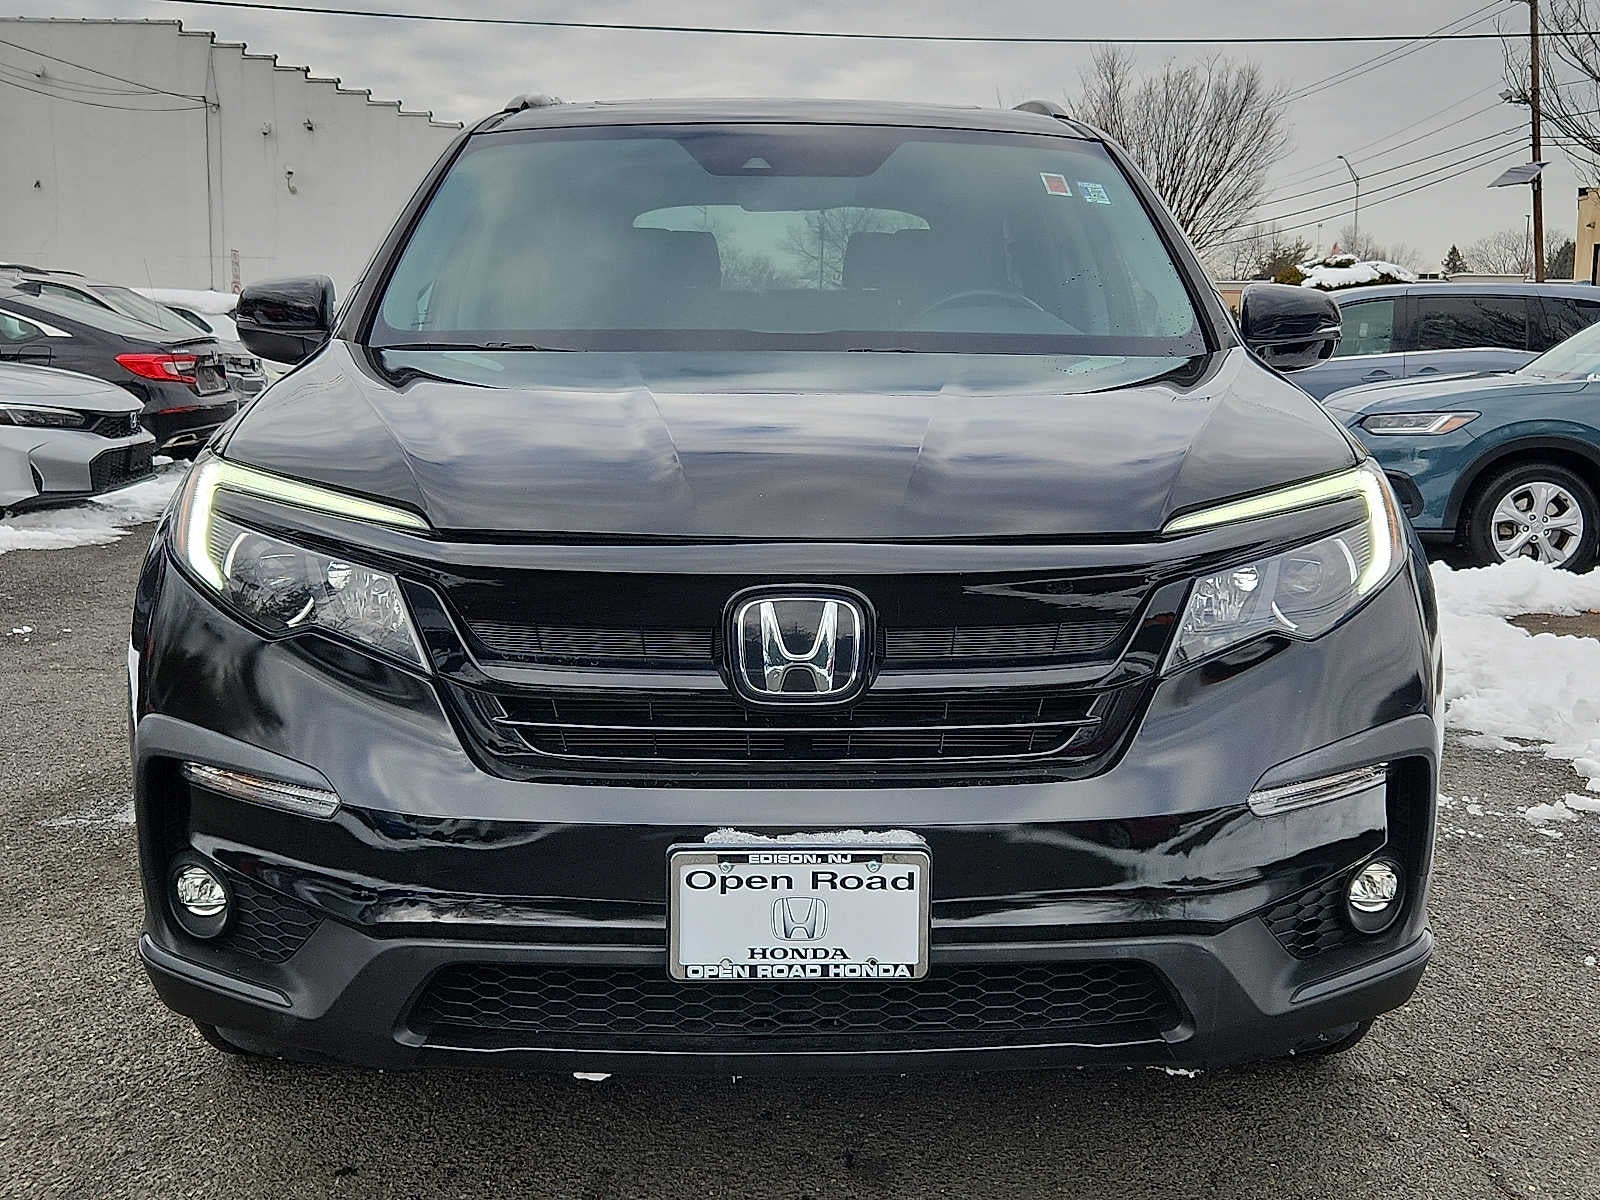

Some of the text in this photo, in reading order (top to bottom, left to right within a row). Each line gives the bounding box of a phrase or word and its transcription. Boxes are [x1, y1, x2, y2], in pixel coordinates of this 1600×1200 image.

[748, 854, 852, 864] EDISON, NJ
[686, 870, 915, 894] Open Road
[748, 947, 851, 960] HONDA
[687, 964, 912, 978] OPEN ROAD HONDA
